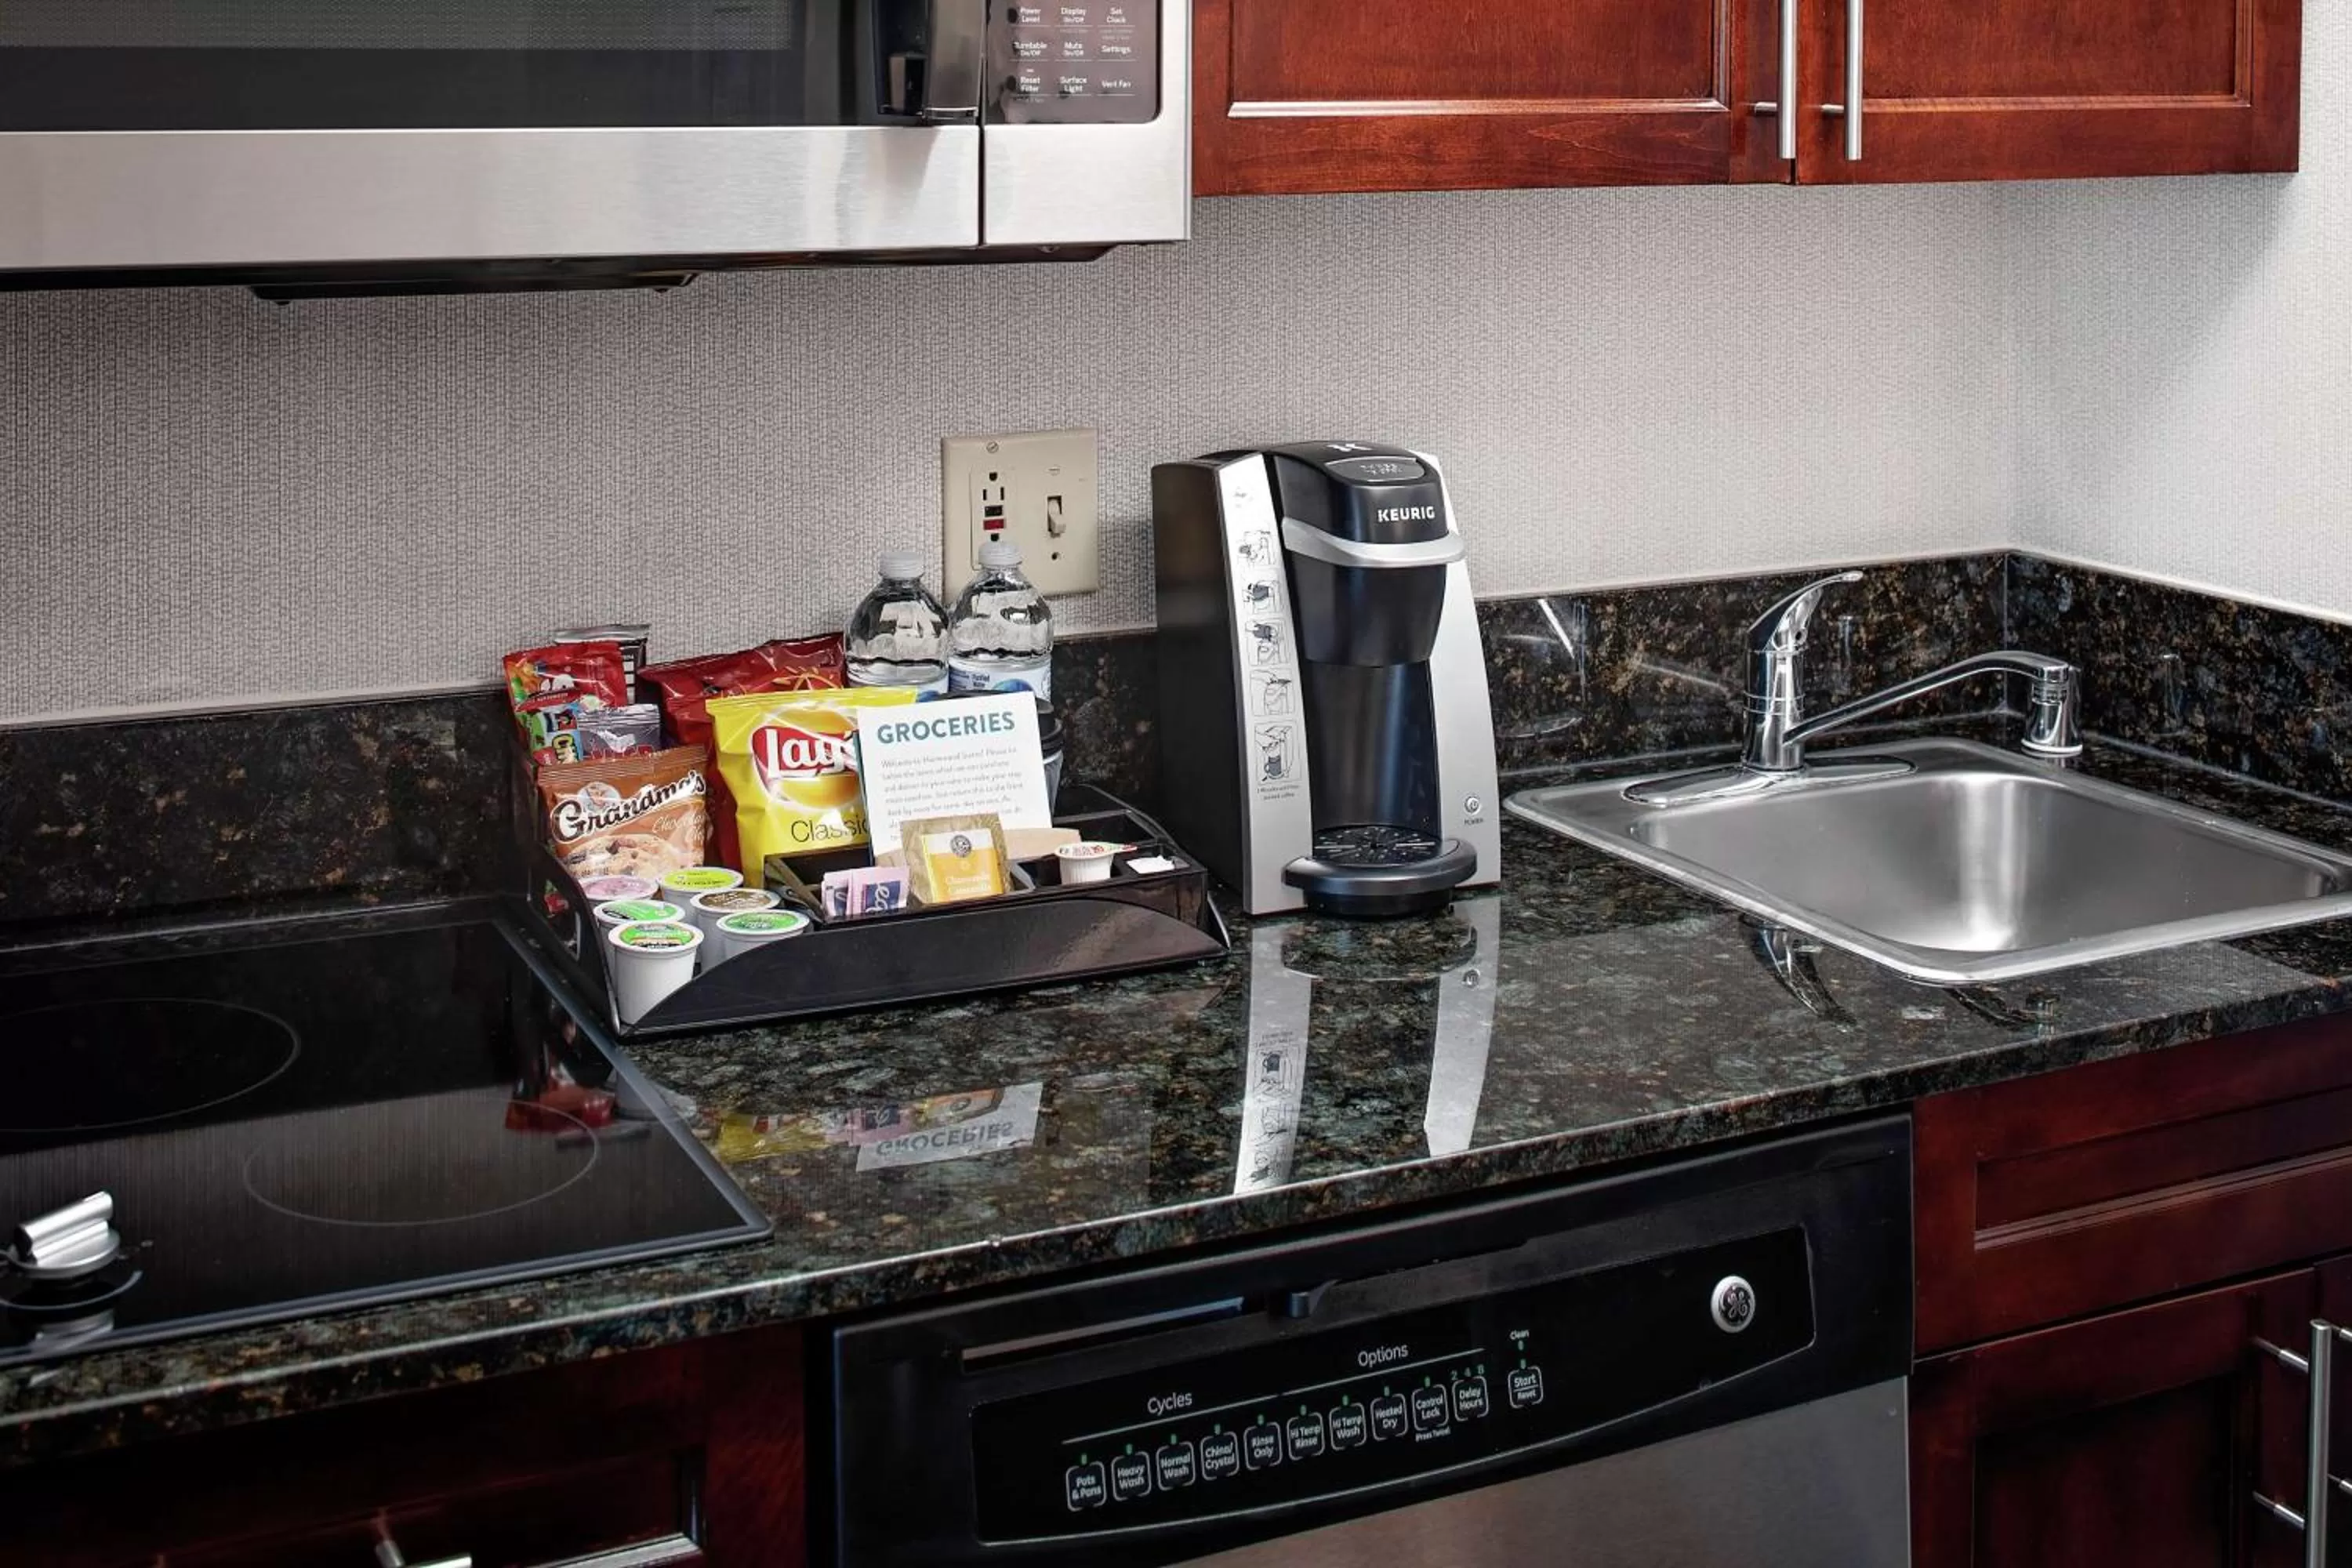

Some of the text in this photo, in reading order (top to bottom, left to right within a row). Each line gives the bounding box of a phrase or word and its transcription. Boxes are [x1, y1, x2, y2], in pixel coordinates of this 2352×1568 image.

[1061, 7, 1087, 16] Display
[1101, 45, 1131, 54] Settings
[1119, 79, 1131, 88] Fan
[1377, 506, 1436, 523] KEURIG
[877, 712, 1015, 743] GROCERIES
[764, 728, 857, 779] Lay
[551, 770, 706, 842] Grandma's
[1357, 1344, 1410, 1367] Options
[1514, 1374, 1537, 1388] Start
[1459, 1386, 1481, 1400] Delay
[1147, 1392, 1192, 1417] Cycles
[1415, 1393, 1444, 1410] Control
[1459, 1396, 1484, 1411] Hours
[1375, 1404, 1403, 1419] Heated
[1421, 1406, 1440, 1421] Lock
[1341, 1414, 1363, 1428] Temp
[1382, 1417, 1399, 1430] Dry
[1300, 1424, 1321, 1437] Temp
[1336, 1426, 1361, 1439] Wash
[1295, 1436, 1318, 1450] Rinse
[1160, 1452, 1191, 1468] Normal
[1254, 1446, 1275, 1459] Only
[1205, 1453, 1236, 1471] Crystal
[1117, 1463, 1145, 1479] Heavy
[1163, 1465, 1189, 1480] Wash
[1076, 1474, 1097, 1488] Pots
[1119, 1475, 1145, 1490] Wash
[1080, 1485, 1102, 1499] Pans
